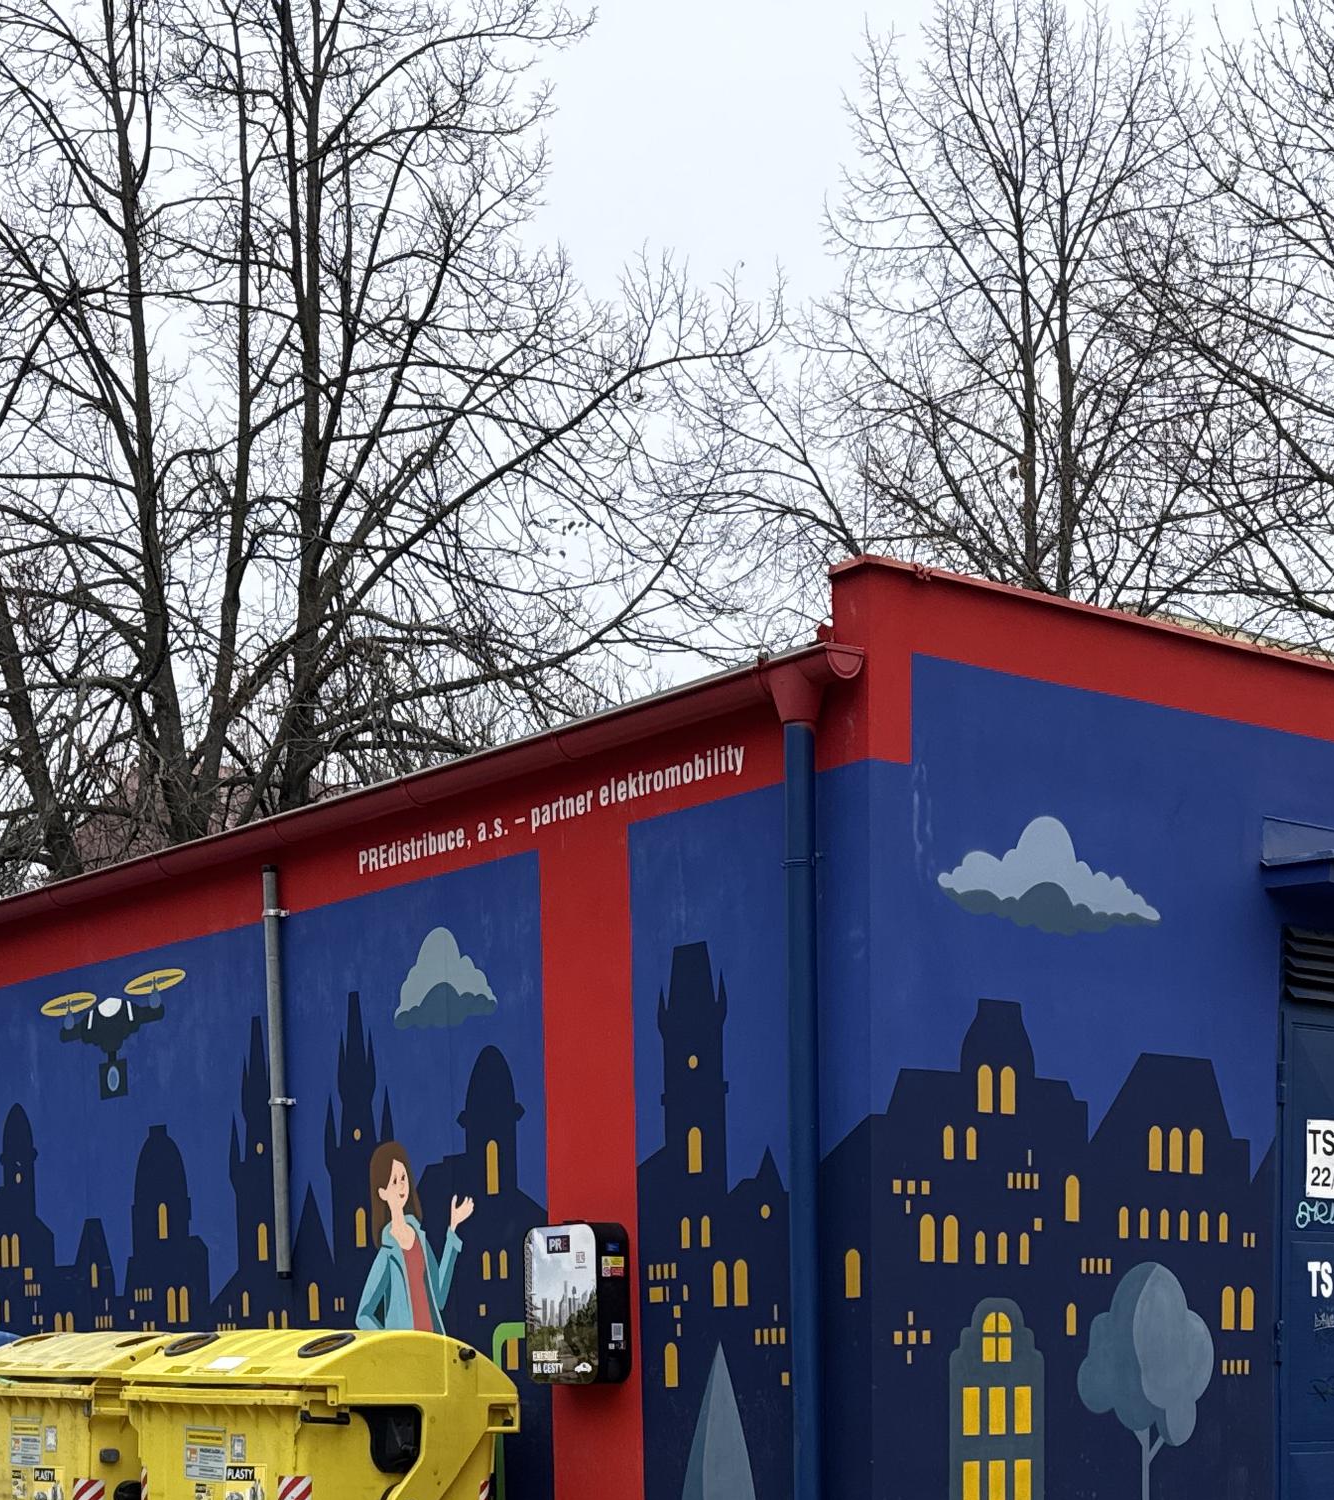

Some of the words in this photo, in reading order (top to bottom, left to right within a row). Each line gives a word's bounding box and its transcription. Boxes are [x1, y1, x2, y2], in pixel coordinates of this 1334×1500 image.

[358, 828, 471, 874] PREdistribuce,
[477, 817, 508, 842] a.s.
[531, 788, 593, 834] partner
[599, 744, 745, 805] elektromobility
[1308, 1129, 1334, 1156] TS
[1307, 1261, 1333, 1298] TS
[228, 1469, 253, 1480] PLASTY
